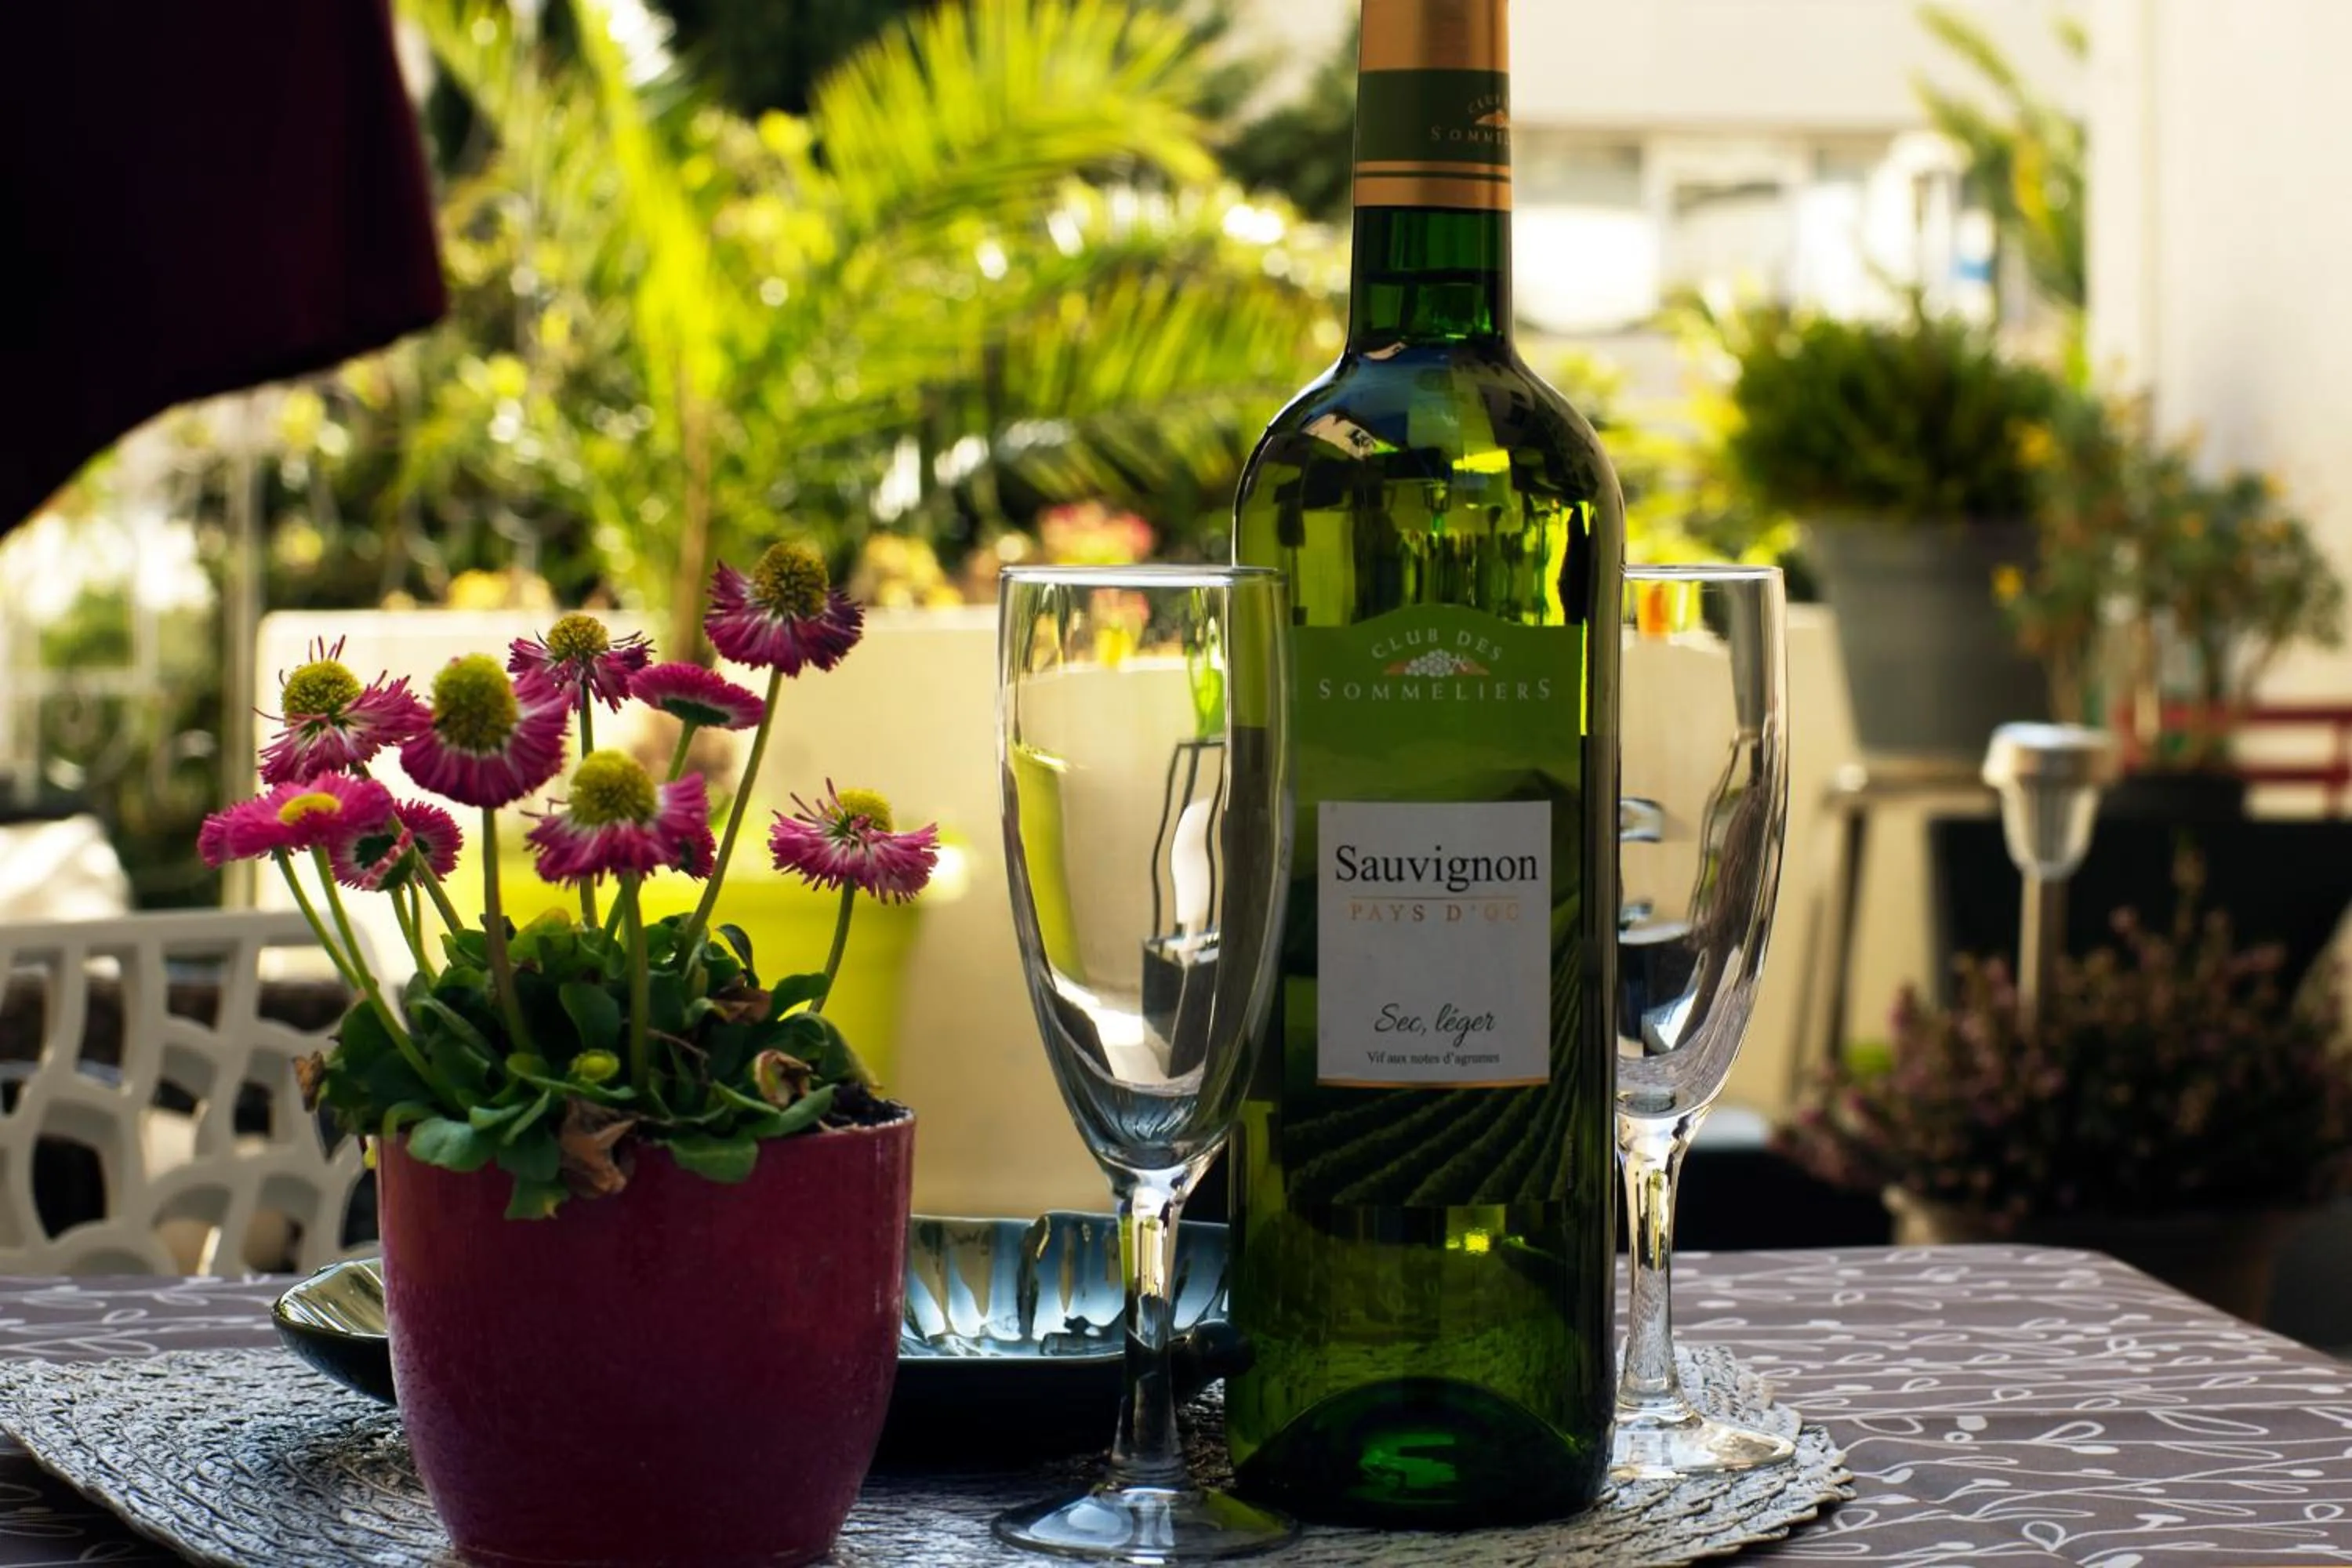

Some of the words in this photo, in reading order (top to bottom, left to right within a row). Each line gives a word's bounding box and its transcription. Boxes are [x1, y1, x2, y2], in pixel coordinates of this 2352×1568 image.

[1371, 627, 1439, 659] CLUB
[1457, 630, 1502, 661] DES
[1318, 677, 1552, 700] SOMMELIERS
[1335, 844, 1538, 892] Sauvignon
[1350, 904, 1425, 922] PAYS
[1446, 902, 1520, 922] D'OC
[1374, 1003, 1427, 1036] Sec,
[1435, 1003, 1496, 1047] léger
[1367, 1051, 1386, 1065] Vif
[1387, 1054, 1407, 1065] aux
[1410, 1053, 1440, 1065] notes
[1443, 1051, 1500, 1067] d'agrumes
